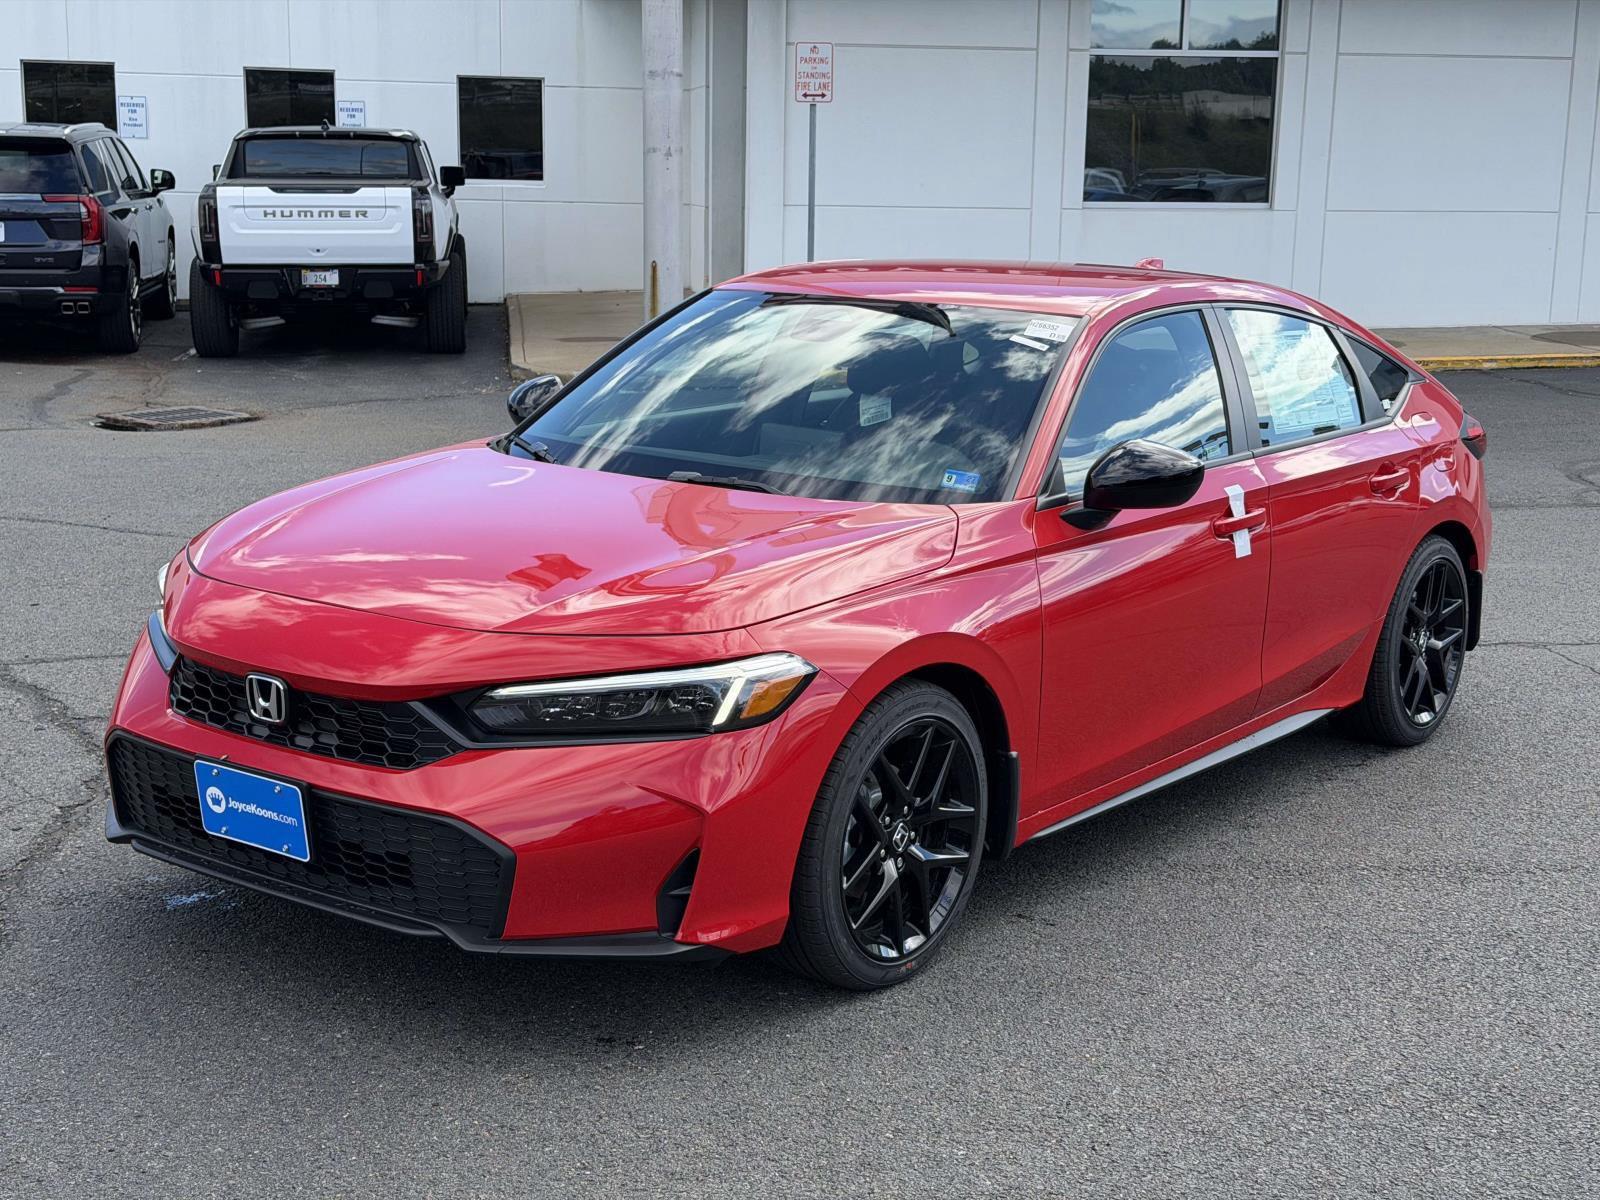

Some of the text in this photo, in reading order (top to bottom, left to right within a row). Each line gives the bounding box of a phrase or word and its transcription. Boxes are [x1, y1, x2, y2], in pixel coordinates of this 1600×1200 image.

[800, 56, 829, 64] PARKING
[798, 71, 830, 79] STANDING
[796, 81, 831, 91] FIRE LANE
[263, 209, 368, 218] HUMMER
[228, 797, 298, 827] JoyceKoons.com
